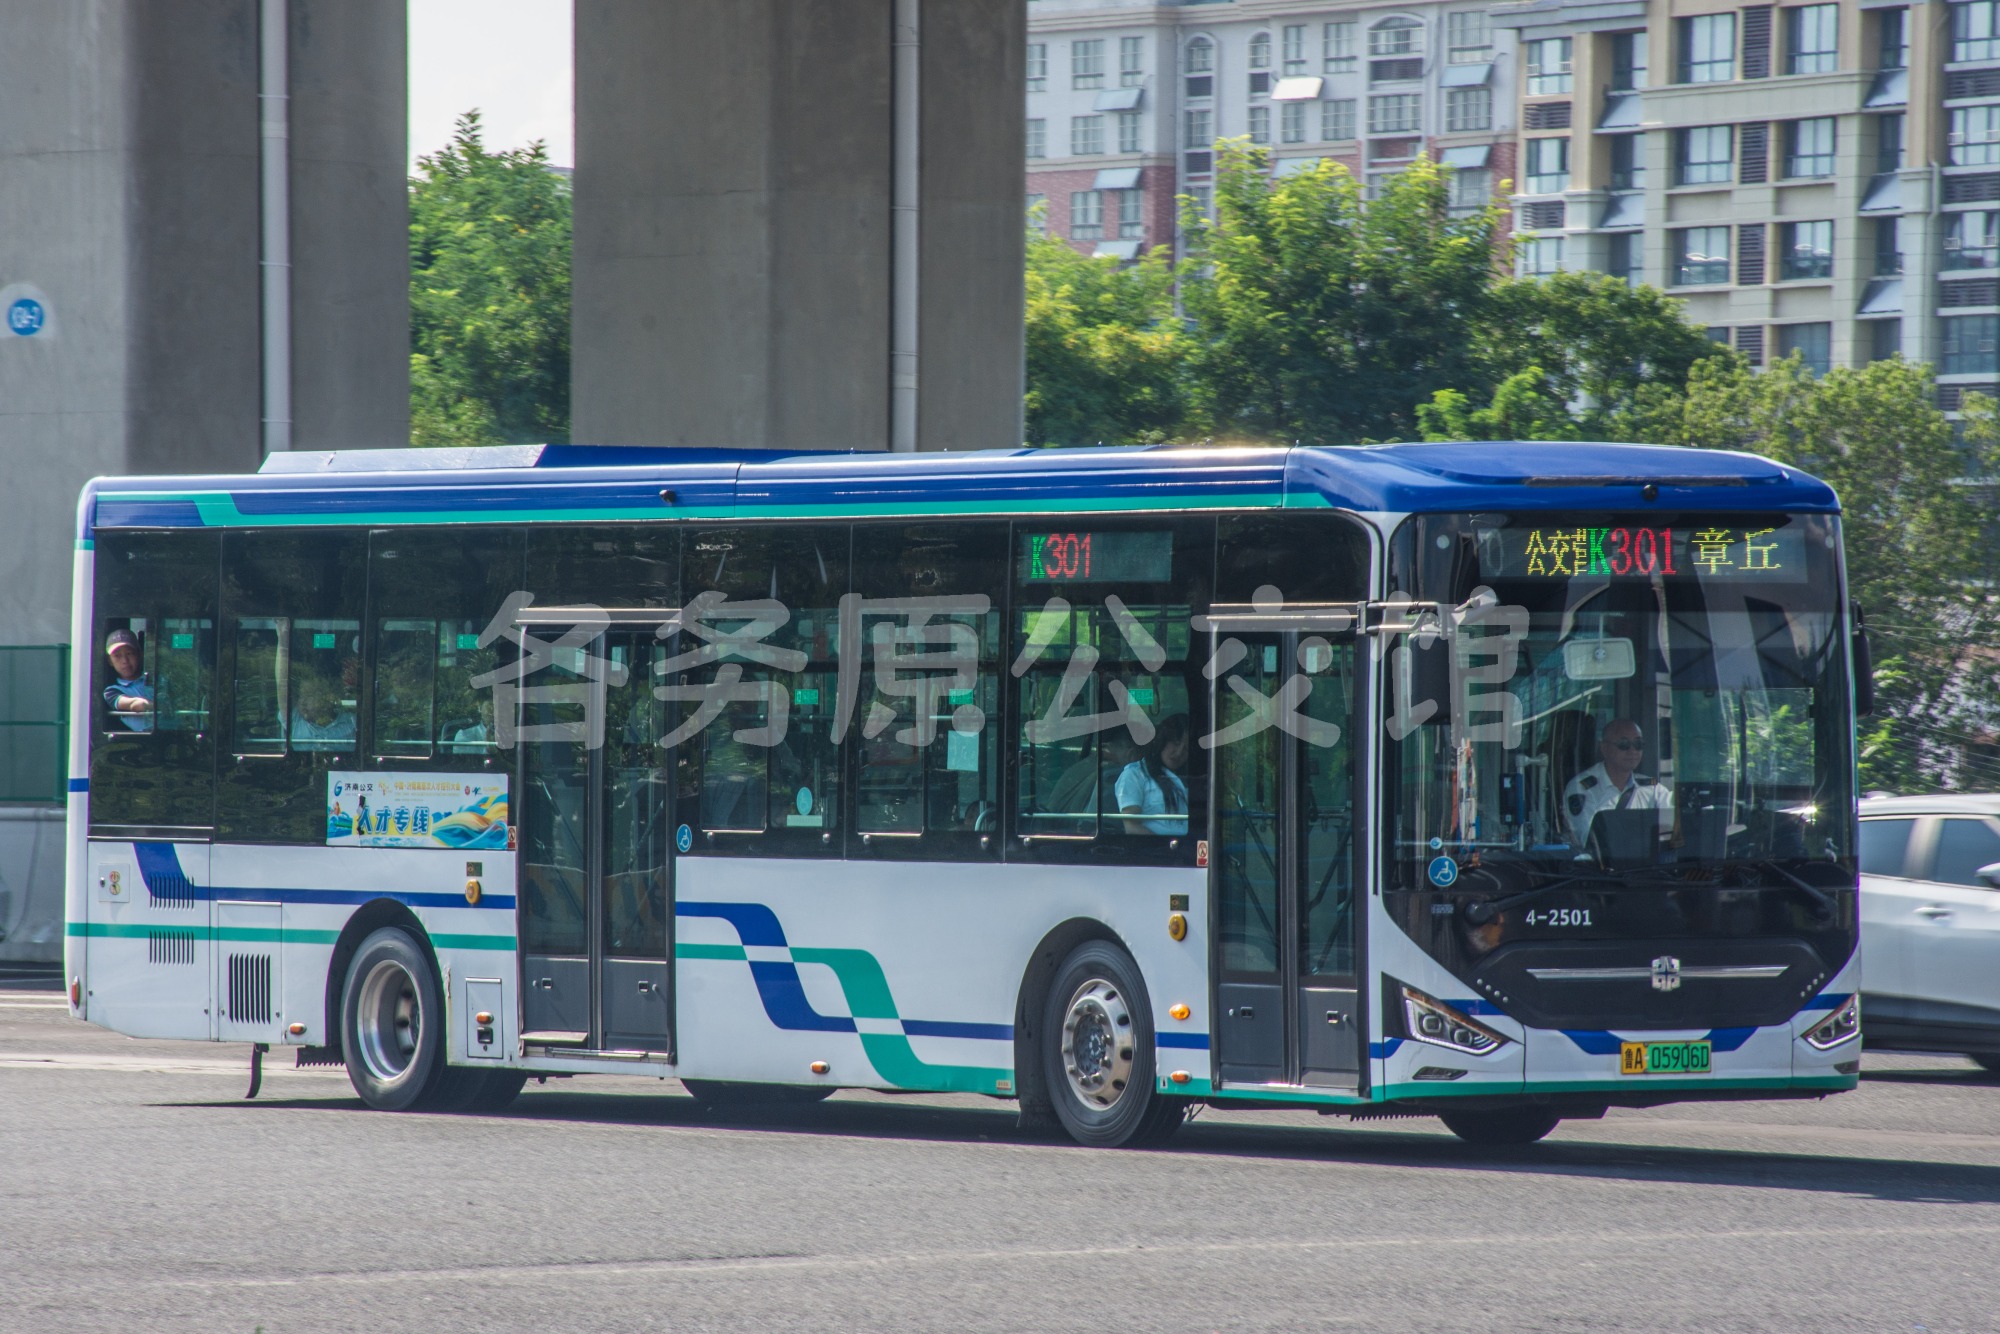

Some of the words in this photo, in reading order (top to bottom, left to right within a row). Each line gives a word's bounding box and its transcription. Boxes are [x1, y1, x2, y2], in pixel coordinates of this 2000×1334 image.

[1031, 533, 1091, 579] K301
[1588, 528, 1676, 575] K301
[1691, 528, 1782, 575] 章丘
[344, 782, 374, 792] 济南公交
[358, 805, 430, 834] 人才专线
[1525, 909, 1592, 926] 4-2501
